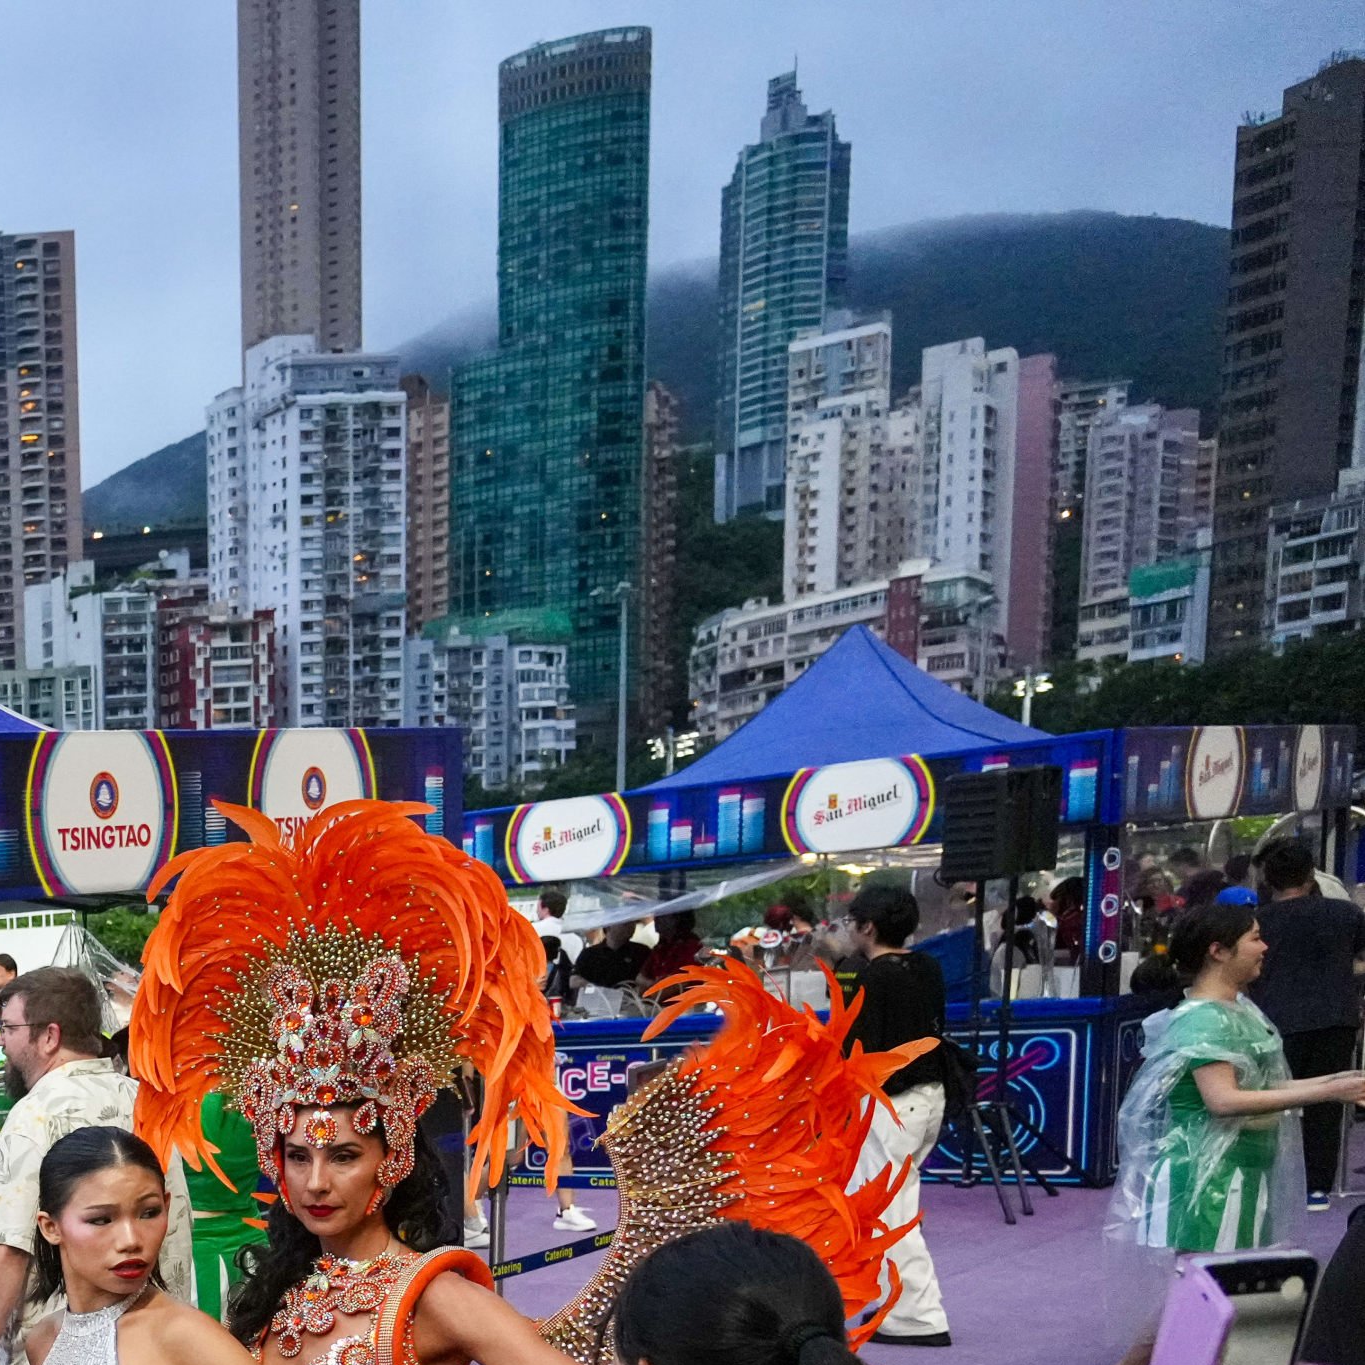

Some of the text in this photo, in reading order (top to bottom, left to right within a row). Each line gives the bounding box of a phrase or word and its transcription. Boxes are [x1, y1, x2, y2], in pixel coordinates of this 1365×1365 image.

[813, 784, 899, 826] San Miguel
[57, 823, 151, 851] TSINGTAO
[532, 818, 601, 856] San Miguel
[492, 1262, 522, 1276] Catering
[544, 1247, 573, 1262] Catering
